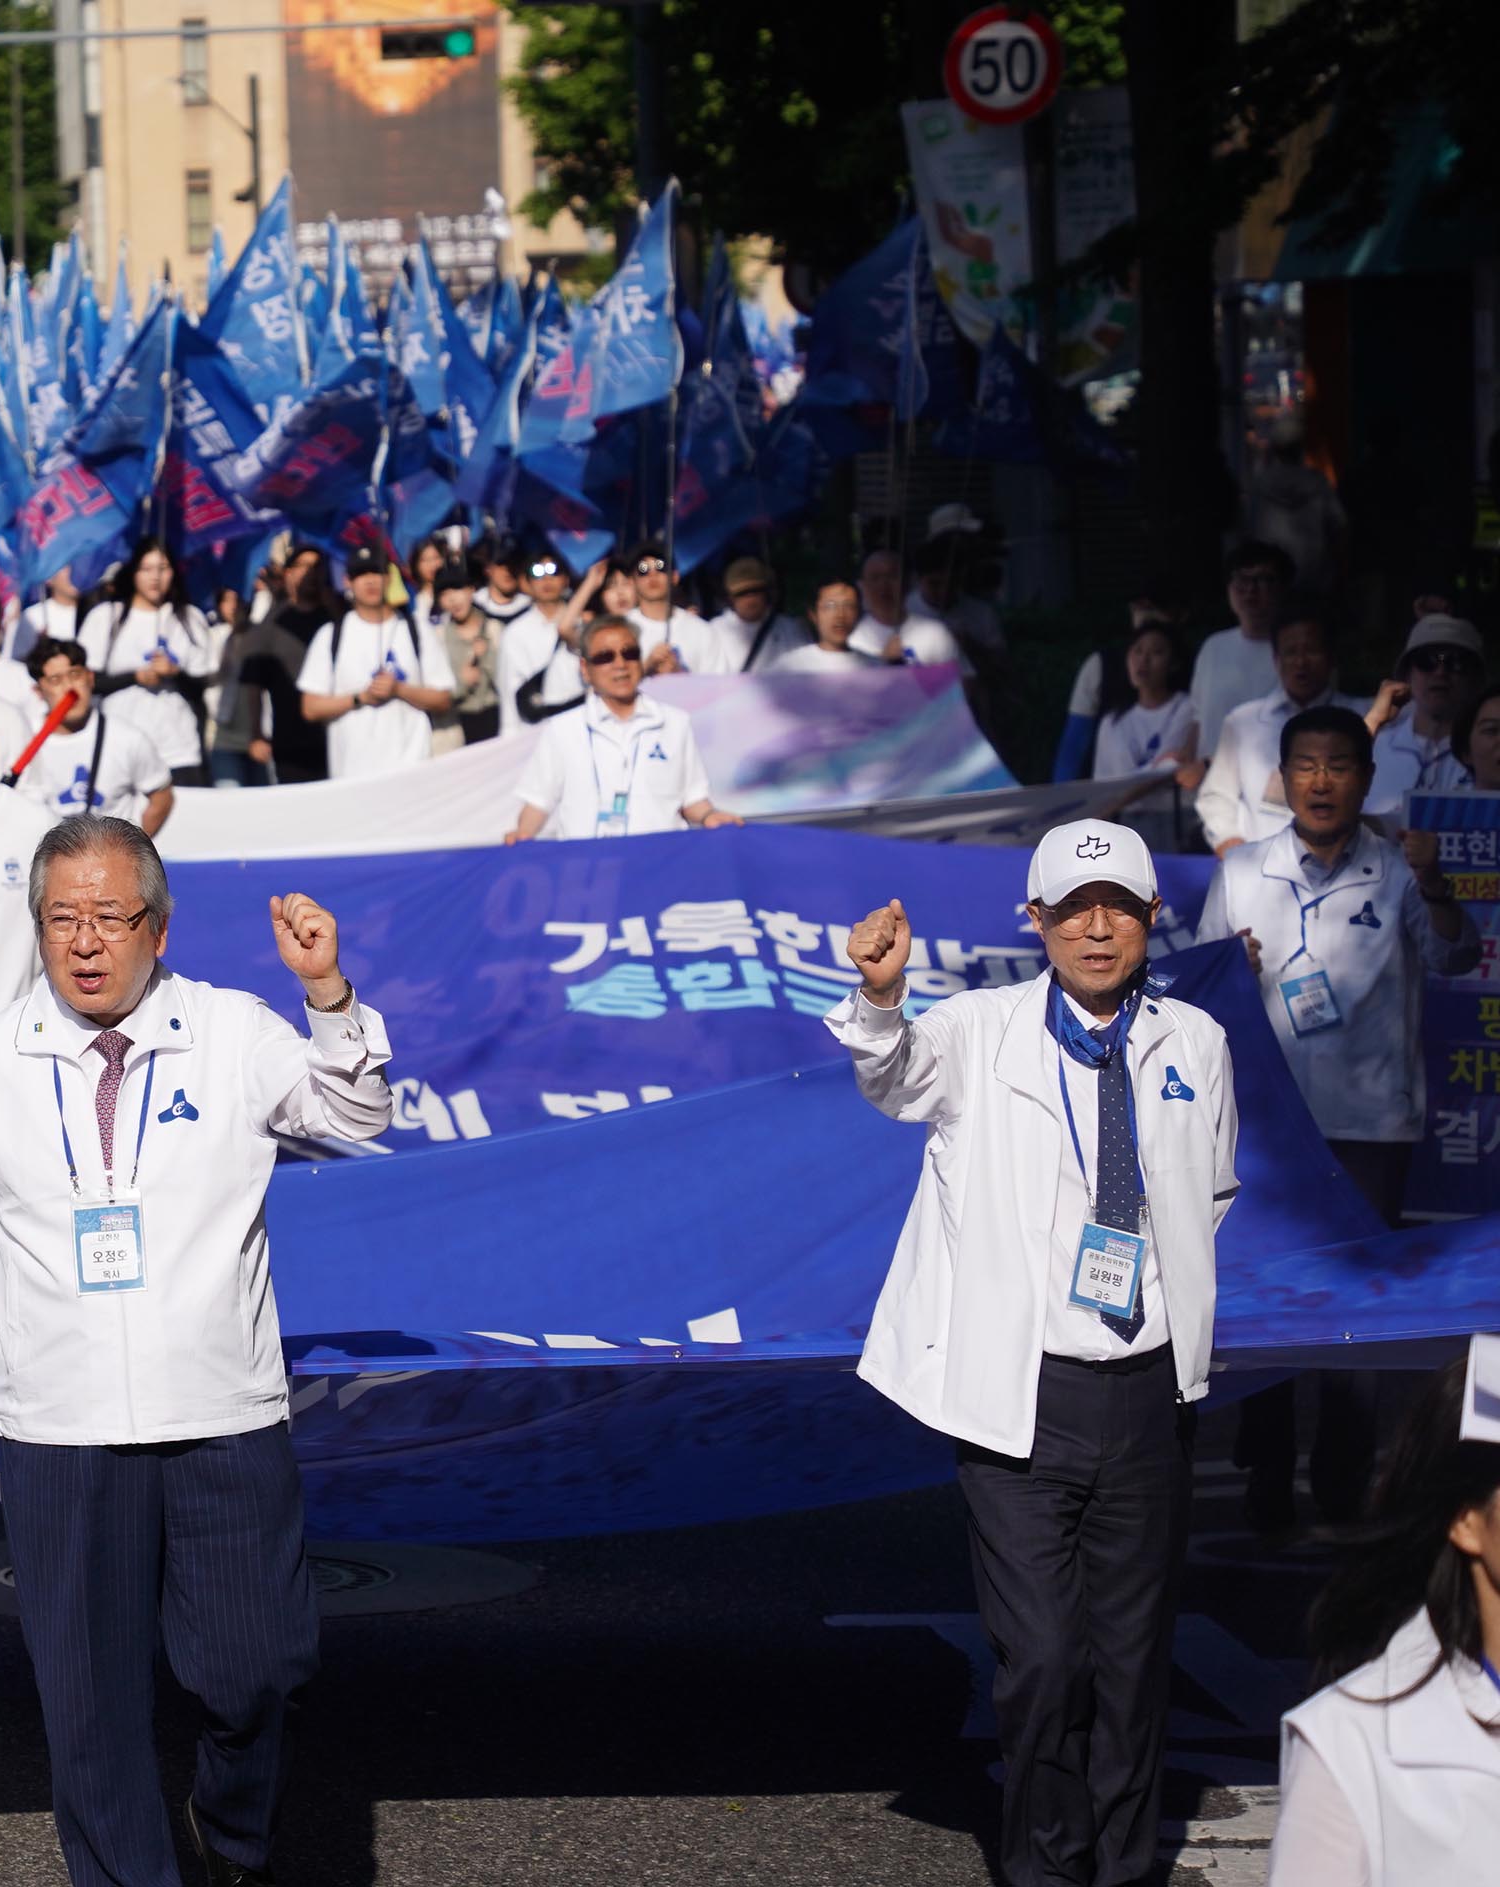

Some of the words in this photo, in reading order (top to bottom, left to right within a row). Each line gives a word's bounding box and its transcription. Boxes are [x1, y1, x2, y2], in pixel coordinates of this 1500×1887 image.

[970, 37, 1039, 97] 50
[1438, 829, 1500, 867] 표현
[93, 1250, 127, 1264] 오정호
[102, 1269, 120, 1280] 목사
[1089, 1266, 1124, 1288] 길원평
[1094, 1289, 1111, 1301] 교수
